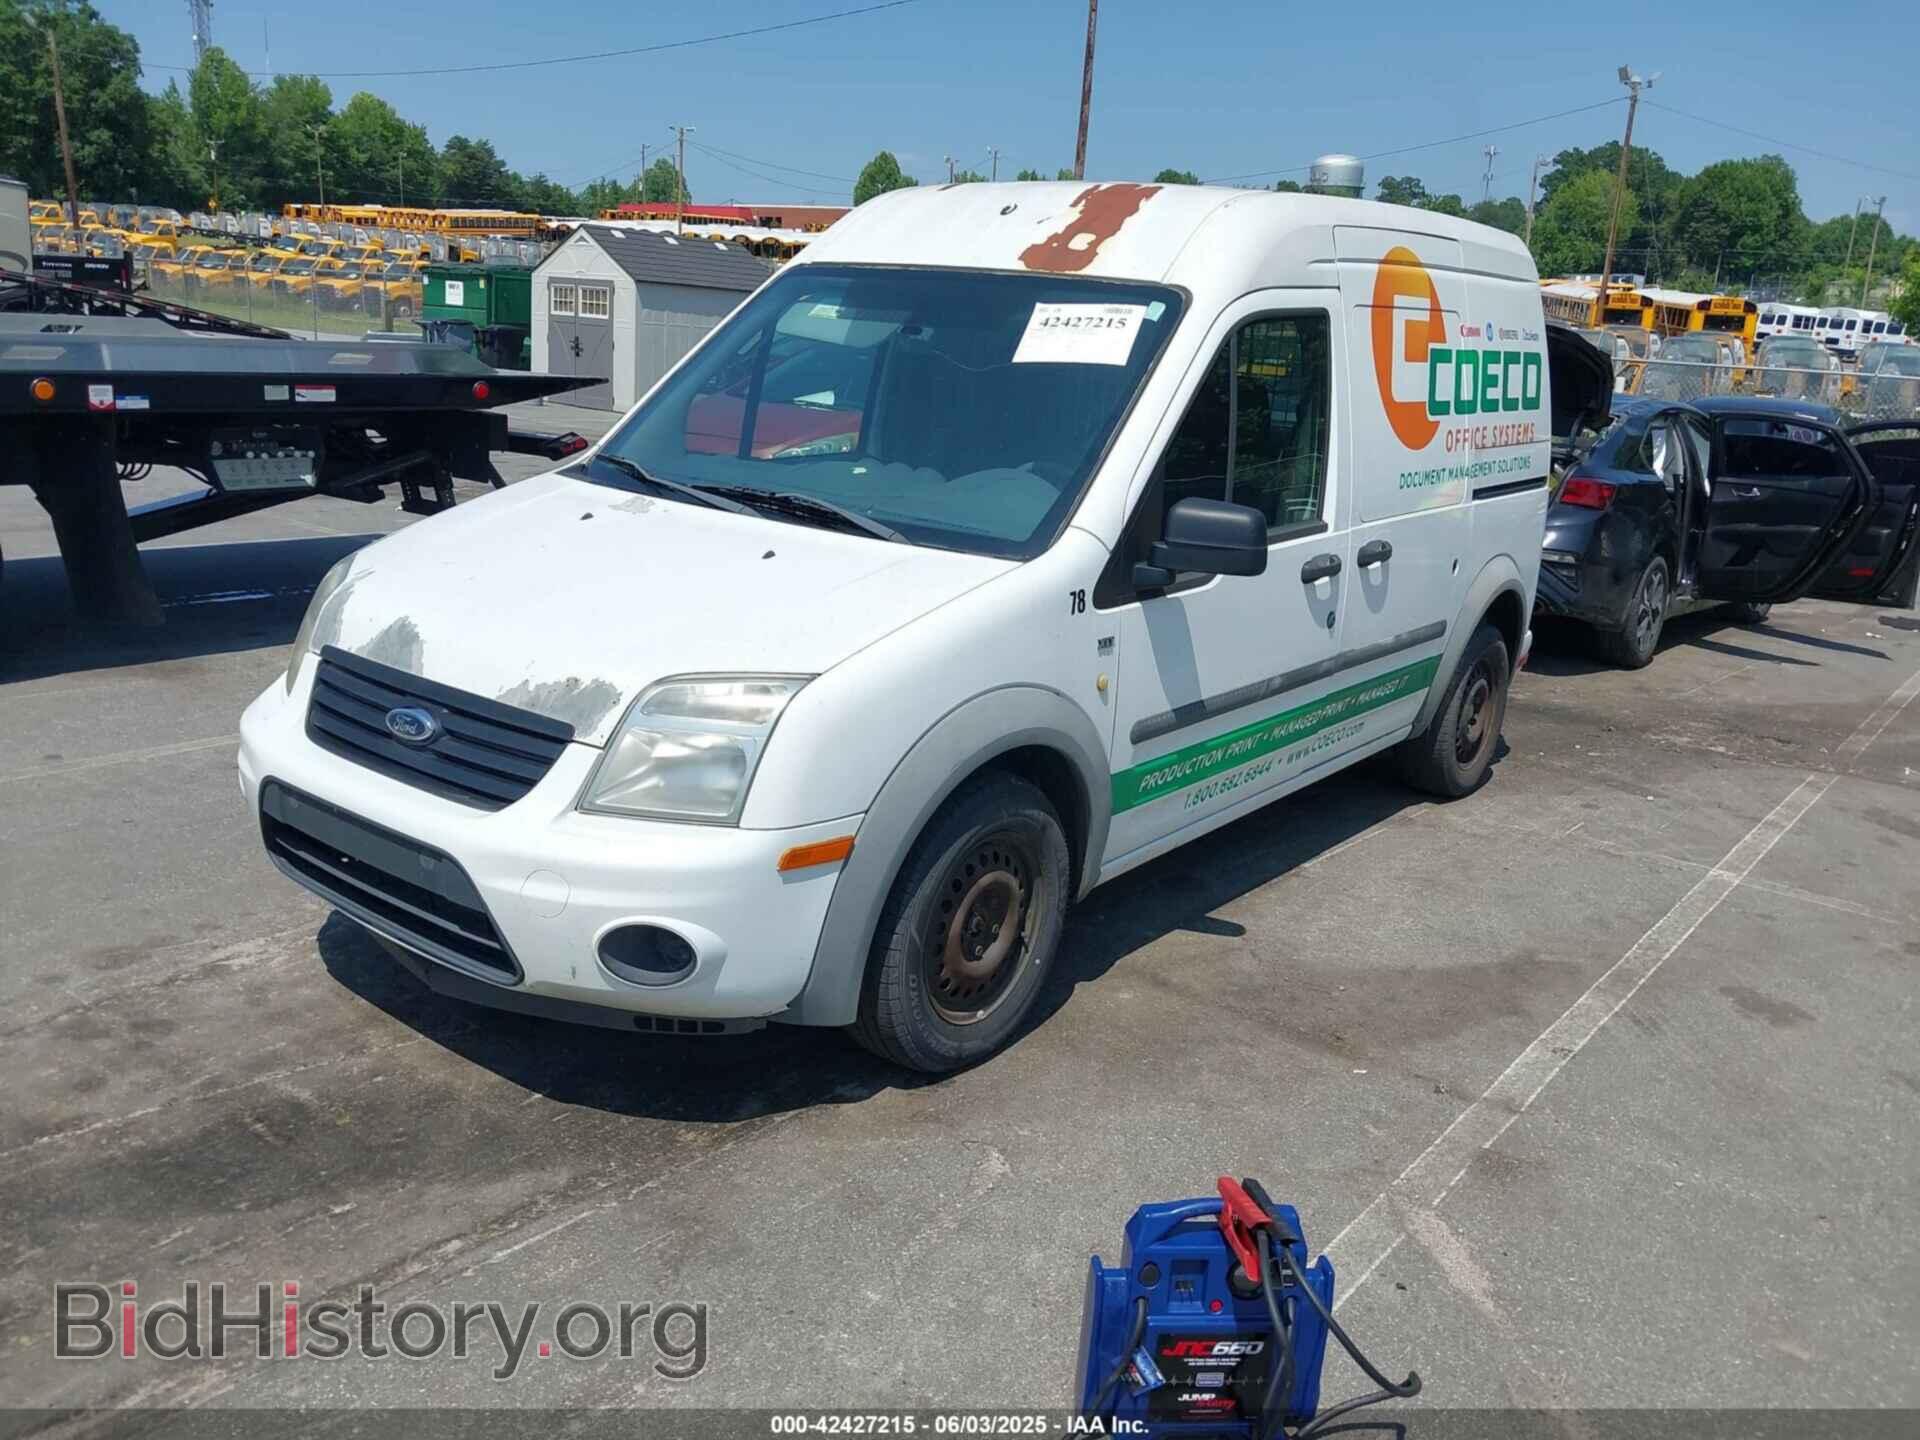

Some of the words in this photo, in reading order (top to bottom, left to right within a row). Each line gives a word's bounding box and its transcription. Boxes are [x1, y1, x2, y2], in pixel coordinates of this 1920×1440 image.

[1039, 316, 1128, 329] 42427215
[1428, 348, 1541, 416] COECO
[1446, 426, 1488, 452] OFFICE
[1492, 422, 1535, 448] SYSTEMS
[1400, 467, 1446, 489] DOCUMENT
[1448, 461, 1496, 481] MANAGEMENT
[1498, 455, 1532, 473] SOLUTIONS
[1069, 589, 1086, 616] 78
[1139, 749, 1225, 792] PRODUCTION
[1225, 733, 1261, 760] PRINT
[1271, 709, 1323, 741] MANAGED
[1161, 1341, 1264, 1356] JNC660
[1177, 1393, 1216, 1401] JUMP
